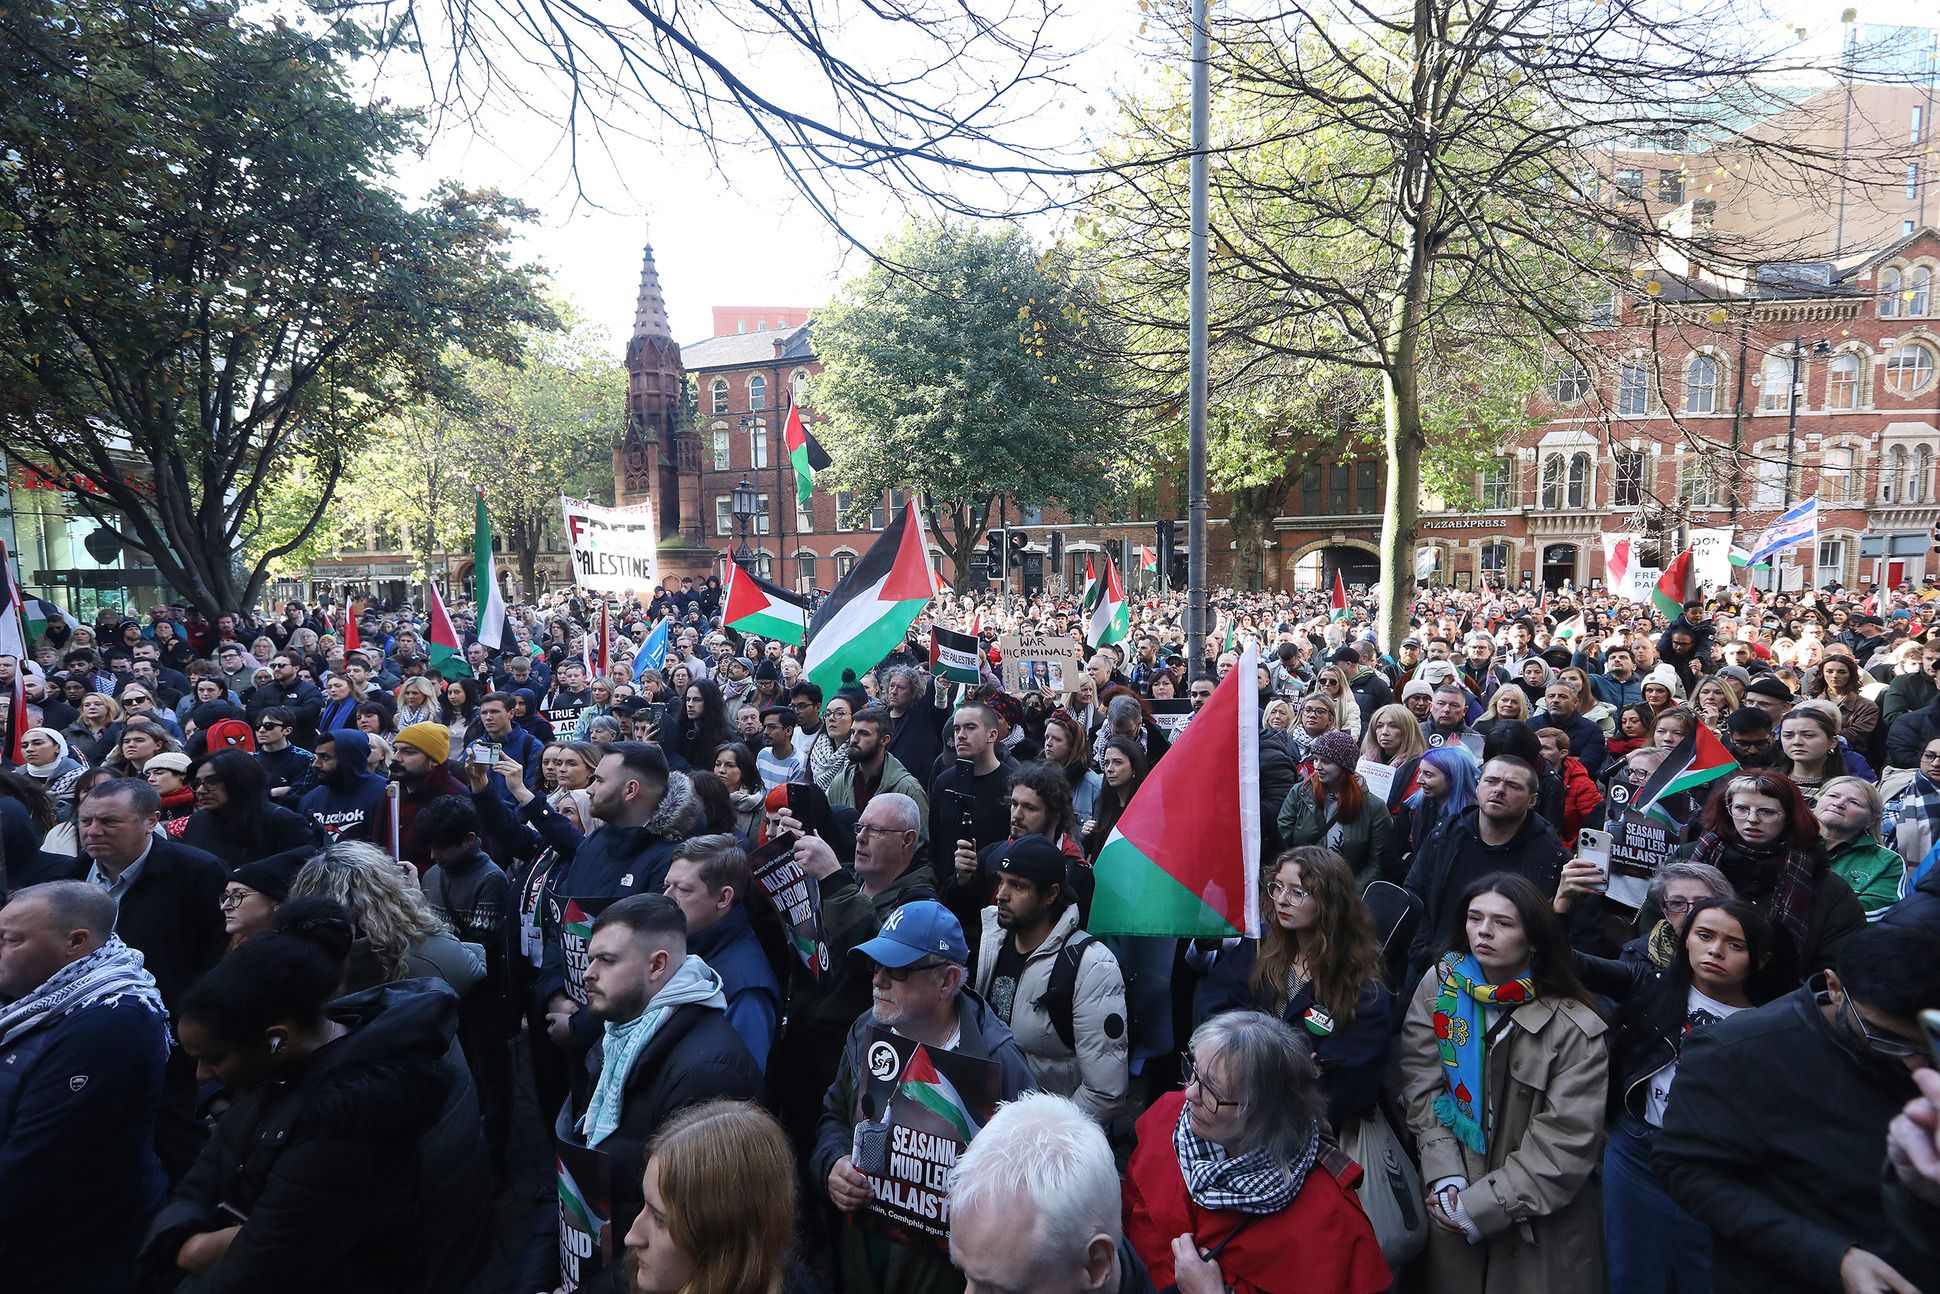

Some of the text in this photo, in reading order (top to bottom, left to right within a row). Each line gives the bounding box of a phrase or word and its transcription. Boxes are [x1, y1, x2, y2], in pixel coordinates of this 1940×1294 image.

[575, 549, 650, 580] PALESTINE
[1019, 637, 1047, 648] WAR
[950, 652, 976, 667] PALESTINE
[548, 708, 575, 720] TRUE
[1158, 717, 1171, 726] FREE
[560, 720, 578, 732] AR
[313, 808, 364, 824] Reebok
[1626, 822, 1665, 842] SEASANN
[1626, 834, 1646, 848] MUID
[1647, 839, 1666, 853] LEIS
[563, 932, 586, 951] WE
[892, 1124, 957, 1167] SEASANN
[890, 1152, 923, 1185] MUID
[864, 1176, 951, 1224] HALAIST
[888, 1210, 924, 1230] Comhphlé
[925, 1224, 944, 1237] agus
